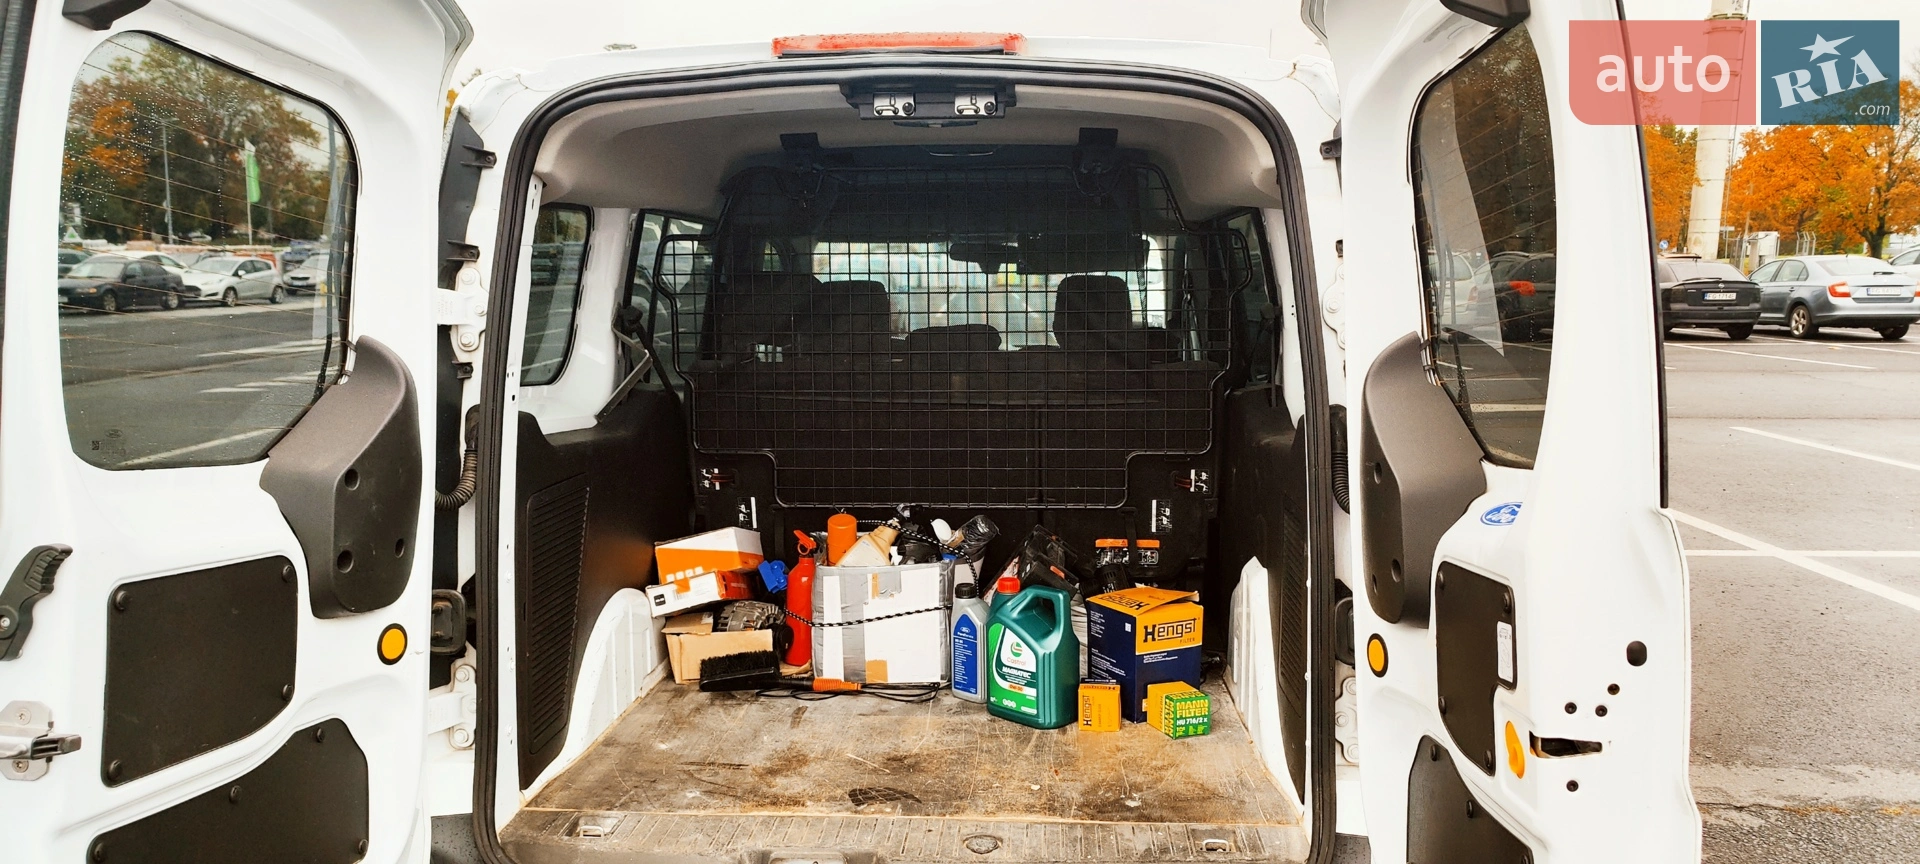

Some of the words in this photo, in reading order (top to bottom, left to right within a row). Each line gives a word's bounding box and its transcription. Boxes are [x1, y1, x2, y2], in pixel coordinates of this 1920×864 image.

[1143, 617, 1197, 643] Hengst
[1006, 656, 1027, 666] Castrol
[1176, 699, 1209, 710] MANN
[1082, 694, 1092, 727] Hengst
[1176, 708, 1209, 718] FILTER
[1176, 718, 1186, 726] HU
[1186, 717, 1203, 725] 716/2
